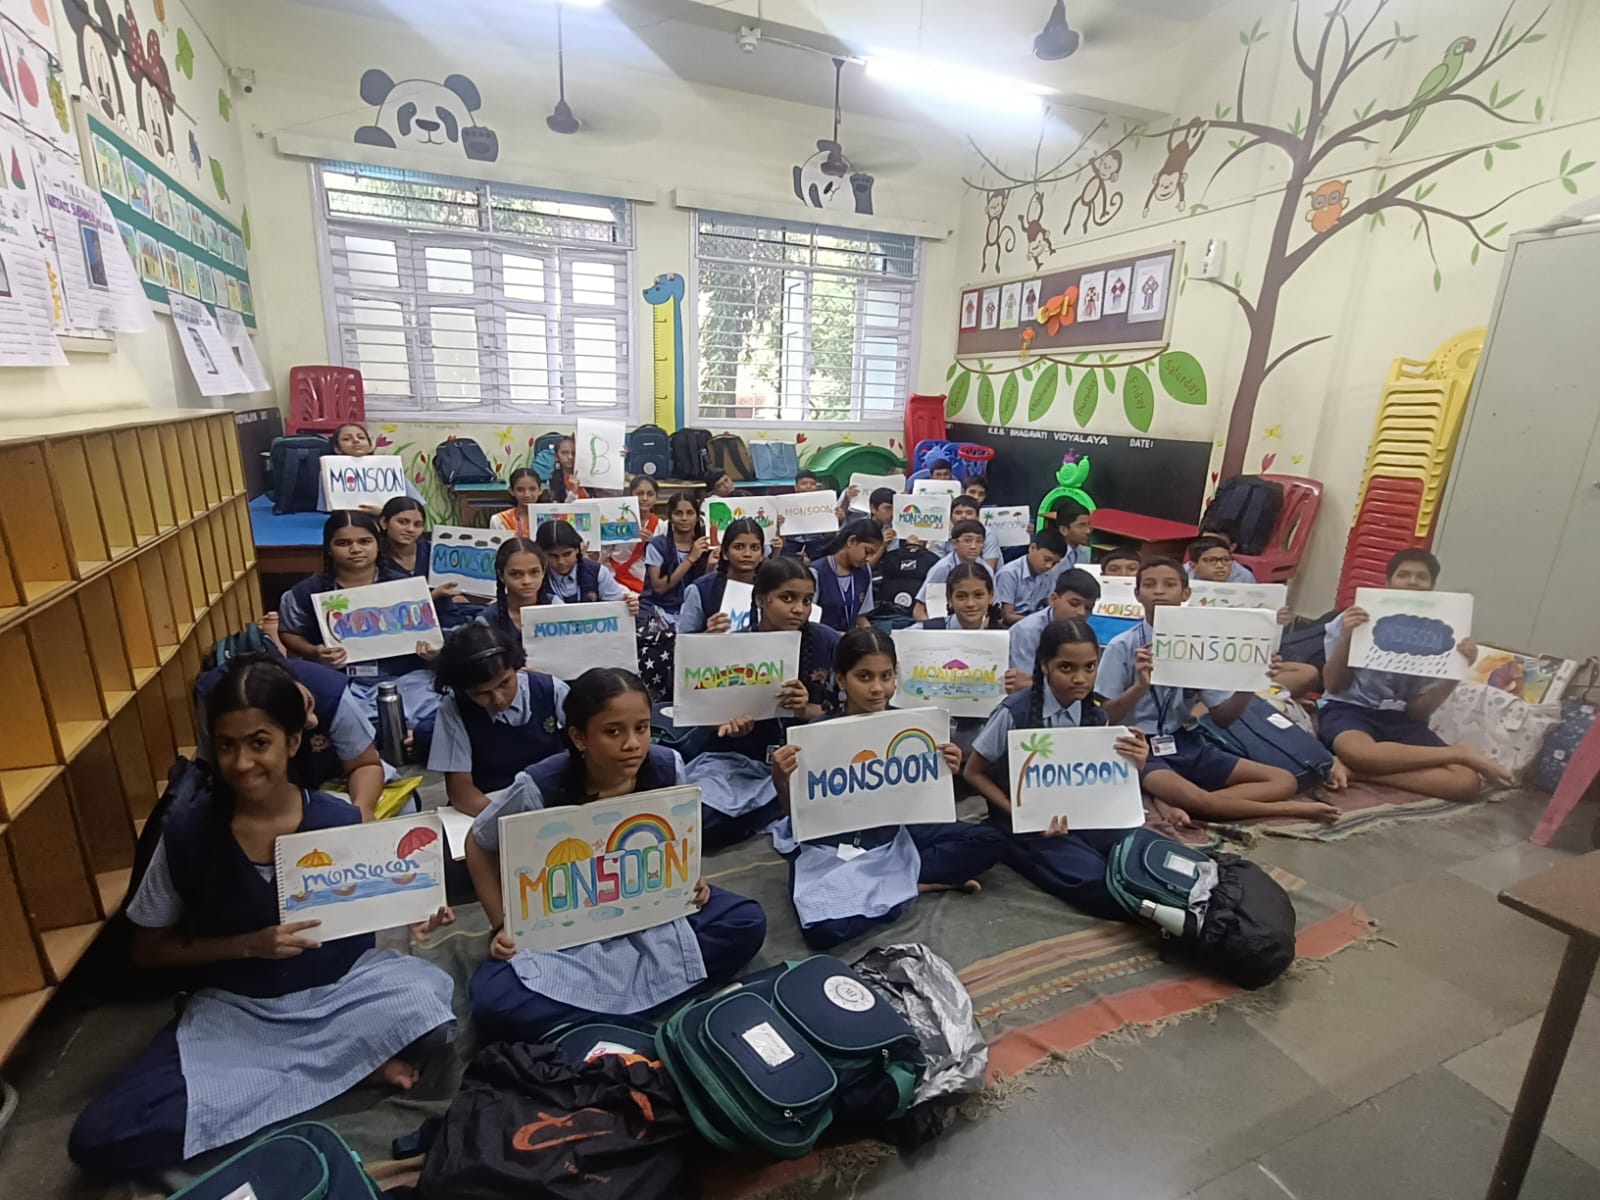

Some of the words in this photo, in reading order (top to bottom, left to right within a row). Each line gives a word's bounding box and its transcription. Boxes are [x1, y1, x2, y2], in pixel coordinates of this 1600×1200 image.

[1163, 358, 1200, 396] Saturday
[1075, 378, 1097, 417] Thursday
[1128, 375, 1146, 410] Friday
[1053, 432, 1109, 446] VIDYALAYA
[329, 467, 405, 493] MONSOON
[784, 504, 834, 517] MONSOON
[898, 512, 943, 525] MONSOON
[1155, 639, 1270, 664] MONSOON
[684, 660, 784, 688] MONSOON
[912, 665, 997, 685] MONSOON
[807, 752, 939, 801] MONSOON
[1024, 759, 1129, 789] MONSOON
[302, 858, 420, 893] monsoon
[519, 838, 689, 921] MONSOON
